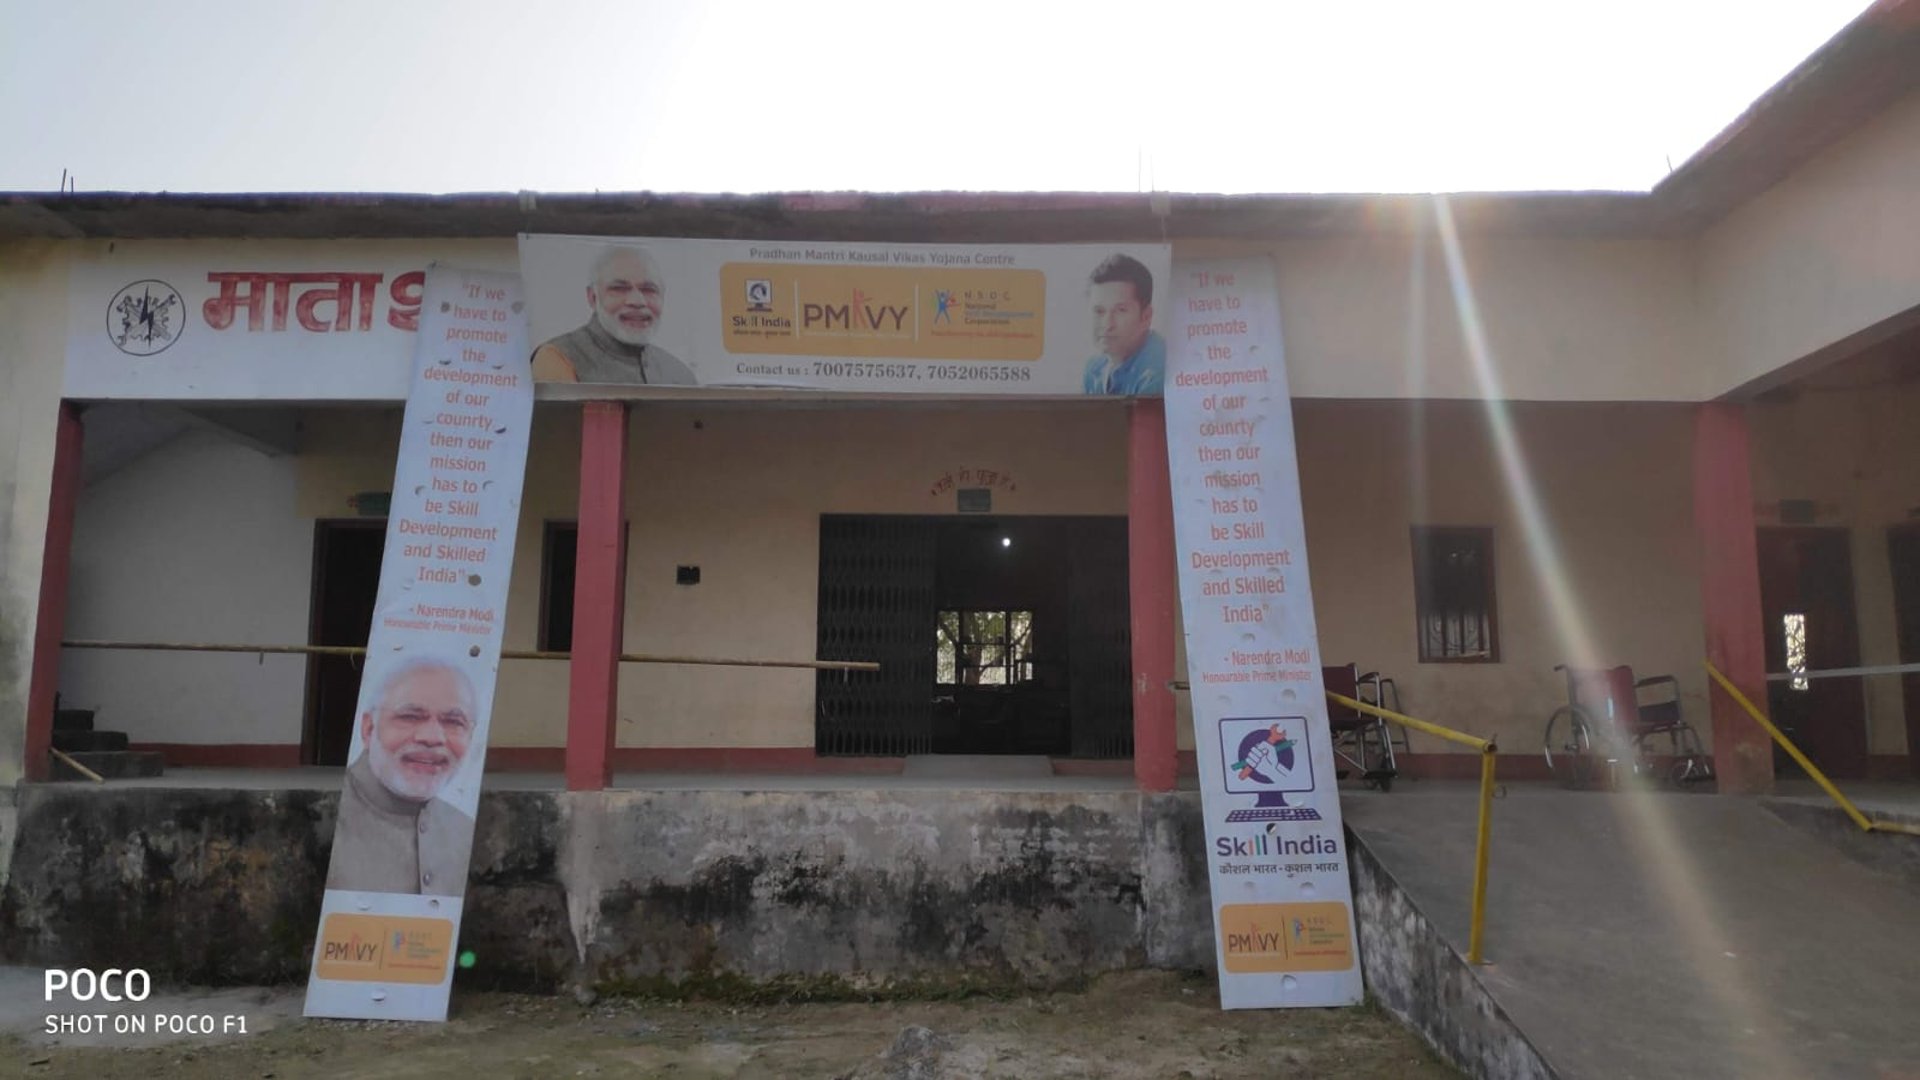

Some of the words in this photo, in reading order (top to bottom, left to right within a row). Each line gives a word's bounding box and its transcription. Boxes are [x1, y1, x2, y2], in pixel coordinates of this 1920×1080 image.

[750, 248, 801, 261] Pradhan
[805, 249, 845, 261] Mantri
[849, 250, 889, 262] Kausal
[894, 252, 925, 263] Vikas
[930, 253, 970, 266] Yojana
[975, 253, 1015, 265] Centre
[1214, 273, 1234, 286] we
[202, 271, 383, 332] माता
[486, 288, 505, 300] we
[1188, 297, 1222, 312] have
[1227, 296, 1240, 309] to
[454, 305, 488, 321] have
[492, 308, 506, 322] to
[732, 316, 758, 327] Skill
[762, 316, 791, 328] India
[446, 328, 507, 343] promote
[1187, 320, 1248, 340] promote
[462, 348, 486, 363] the
[1208, 345, 1231, 360] the
[423, 366, 518, 387] development
[737, 363, 783, 376] Contact
[787, 365, 800, 375] us
[814, 362, 921, 381] 7007575637,
[928, 366, 1030, 382] 7052065588
[1175, 367, 1269, 387] development
[446, 390, 461, 404] of
[465, 394, 489, 406] our
[1203, 394, 1216, 410] of
[1223, 395, 1247, 408] our
[436, 412, 492, 430] counrty
[1200, 419, 1255, 438] counrty
[430, 432, 463, 448] then
[468, 436, 493, 449] our
[1198, 446, 1232, 462] then
[1237, 446, 1260, 460] our
[430, 454, 486, 472] mission
[432, 477, 457, 492] has
[463, 480, 477, 494] to
[1204, 471, 1260, 489] mission
[424, 499, 442, 513] be
[447, 501, 479, 517] Skill
[1212, 497, 1238, 514] has
[1243, 497, 1258, 513] to
[399, 519, 498, 541] Development
[1211, 525, 1229, 541] be
[1234, 522, 1264, 540] Skill
[404, 544, 432, 558] and
[436, 545, 486, 562] Skilled
[1191, 551, 1292, 570] Development
[1202, 578, 1231, 596] and
[1235, 575, 1285, 594] Skilled
[416, 604, 466, 619] Narendra
[1231, 650, 1282, 666] Narendra
[1285, 649, 1310, 664] Modi
[1252, 671, 1277, 683] Prime
[1216, 834, 1268, 857] Skill
[1277, 834, 1337, 855] India
[1254, 864, 1277, 874] भारत
[1315, 862, 1339, 872] भारत
